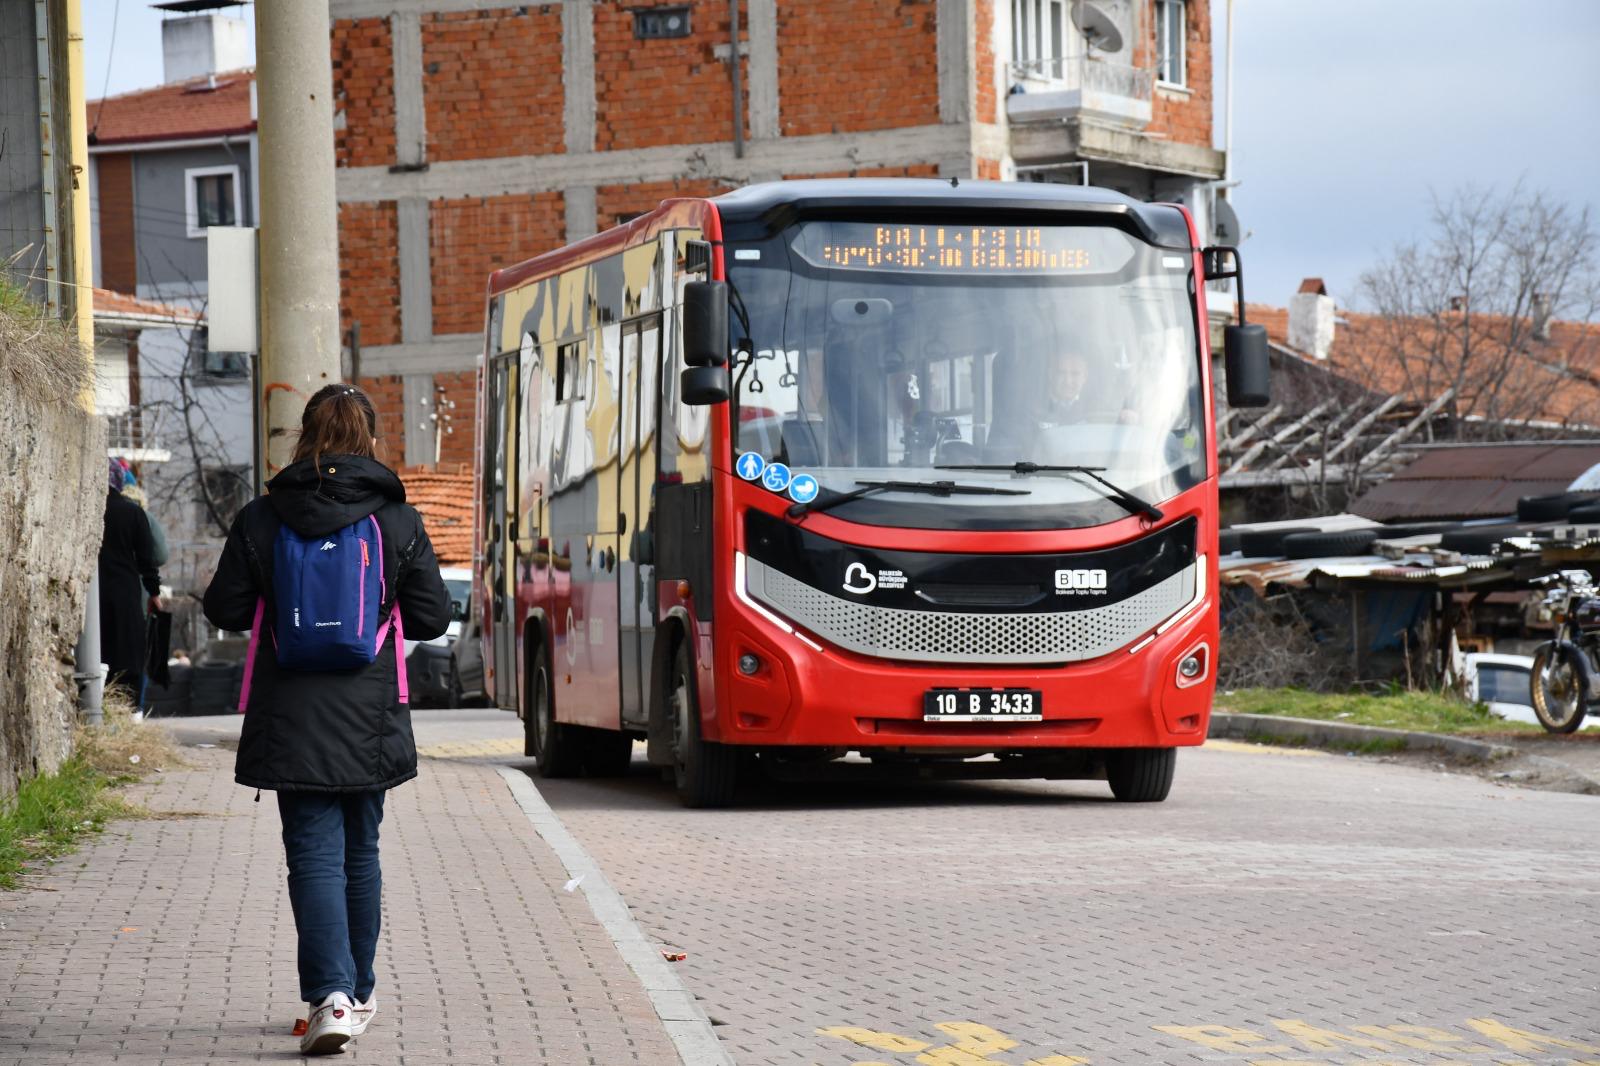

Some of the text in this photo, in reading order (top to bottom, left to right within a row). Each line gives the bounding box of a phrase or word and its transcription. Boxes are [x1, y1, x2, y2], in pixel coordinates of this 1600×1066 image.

[1057, 571, 1105, 587] BTT
[936, 694, 1033, 714] 10 B 3433
